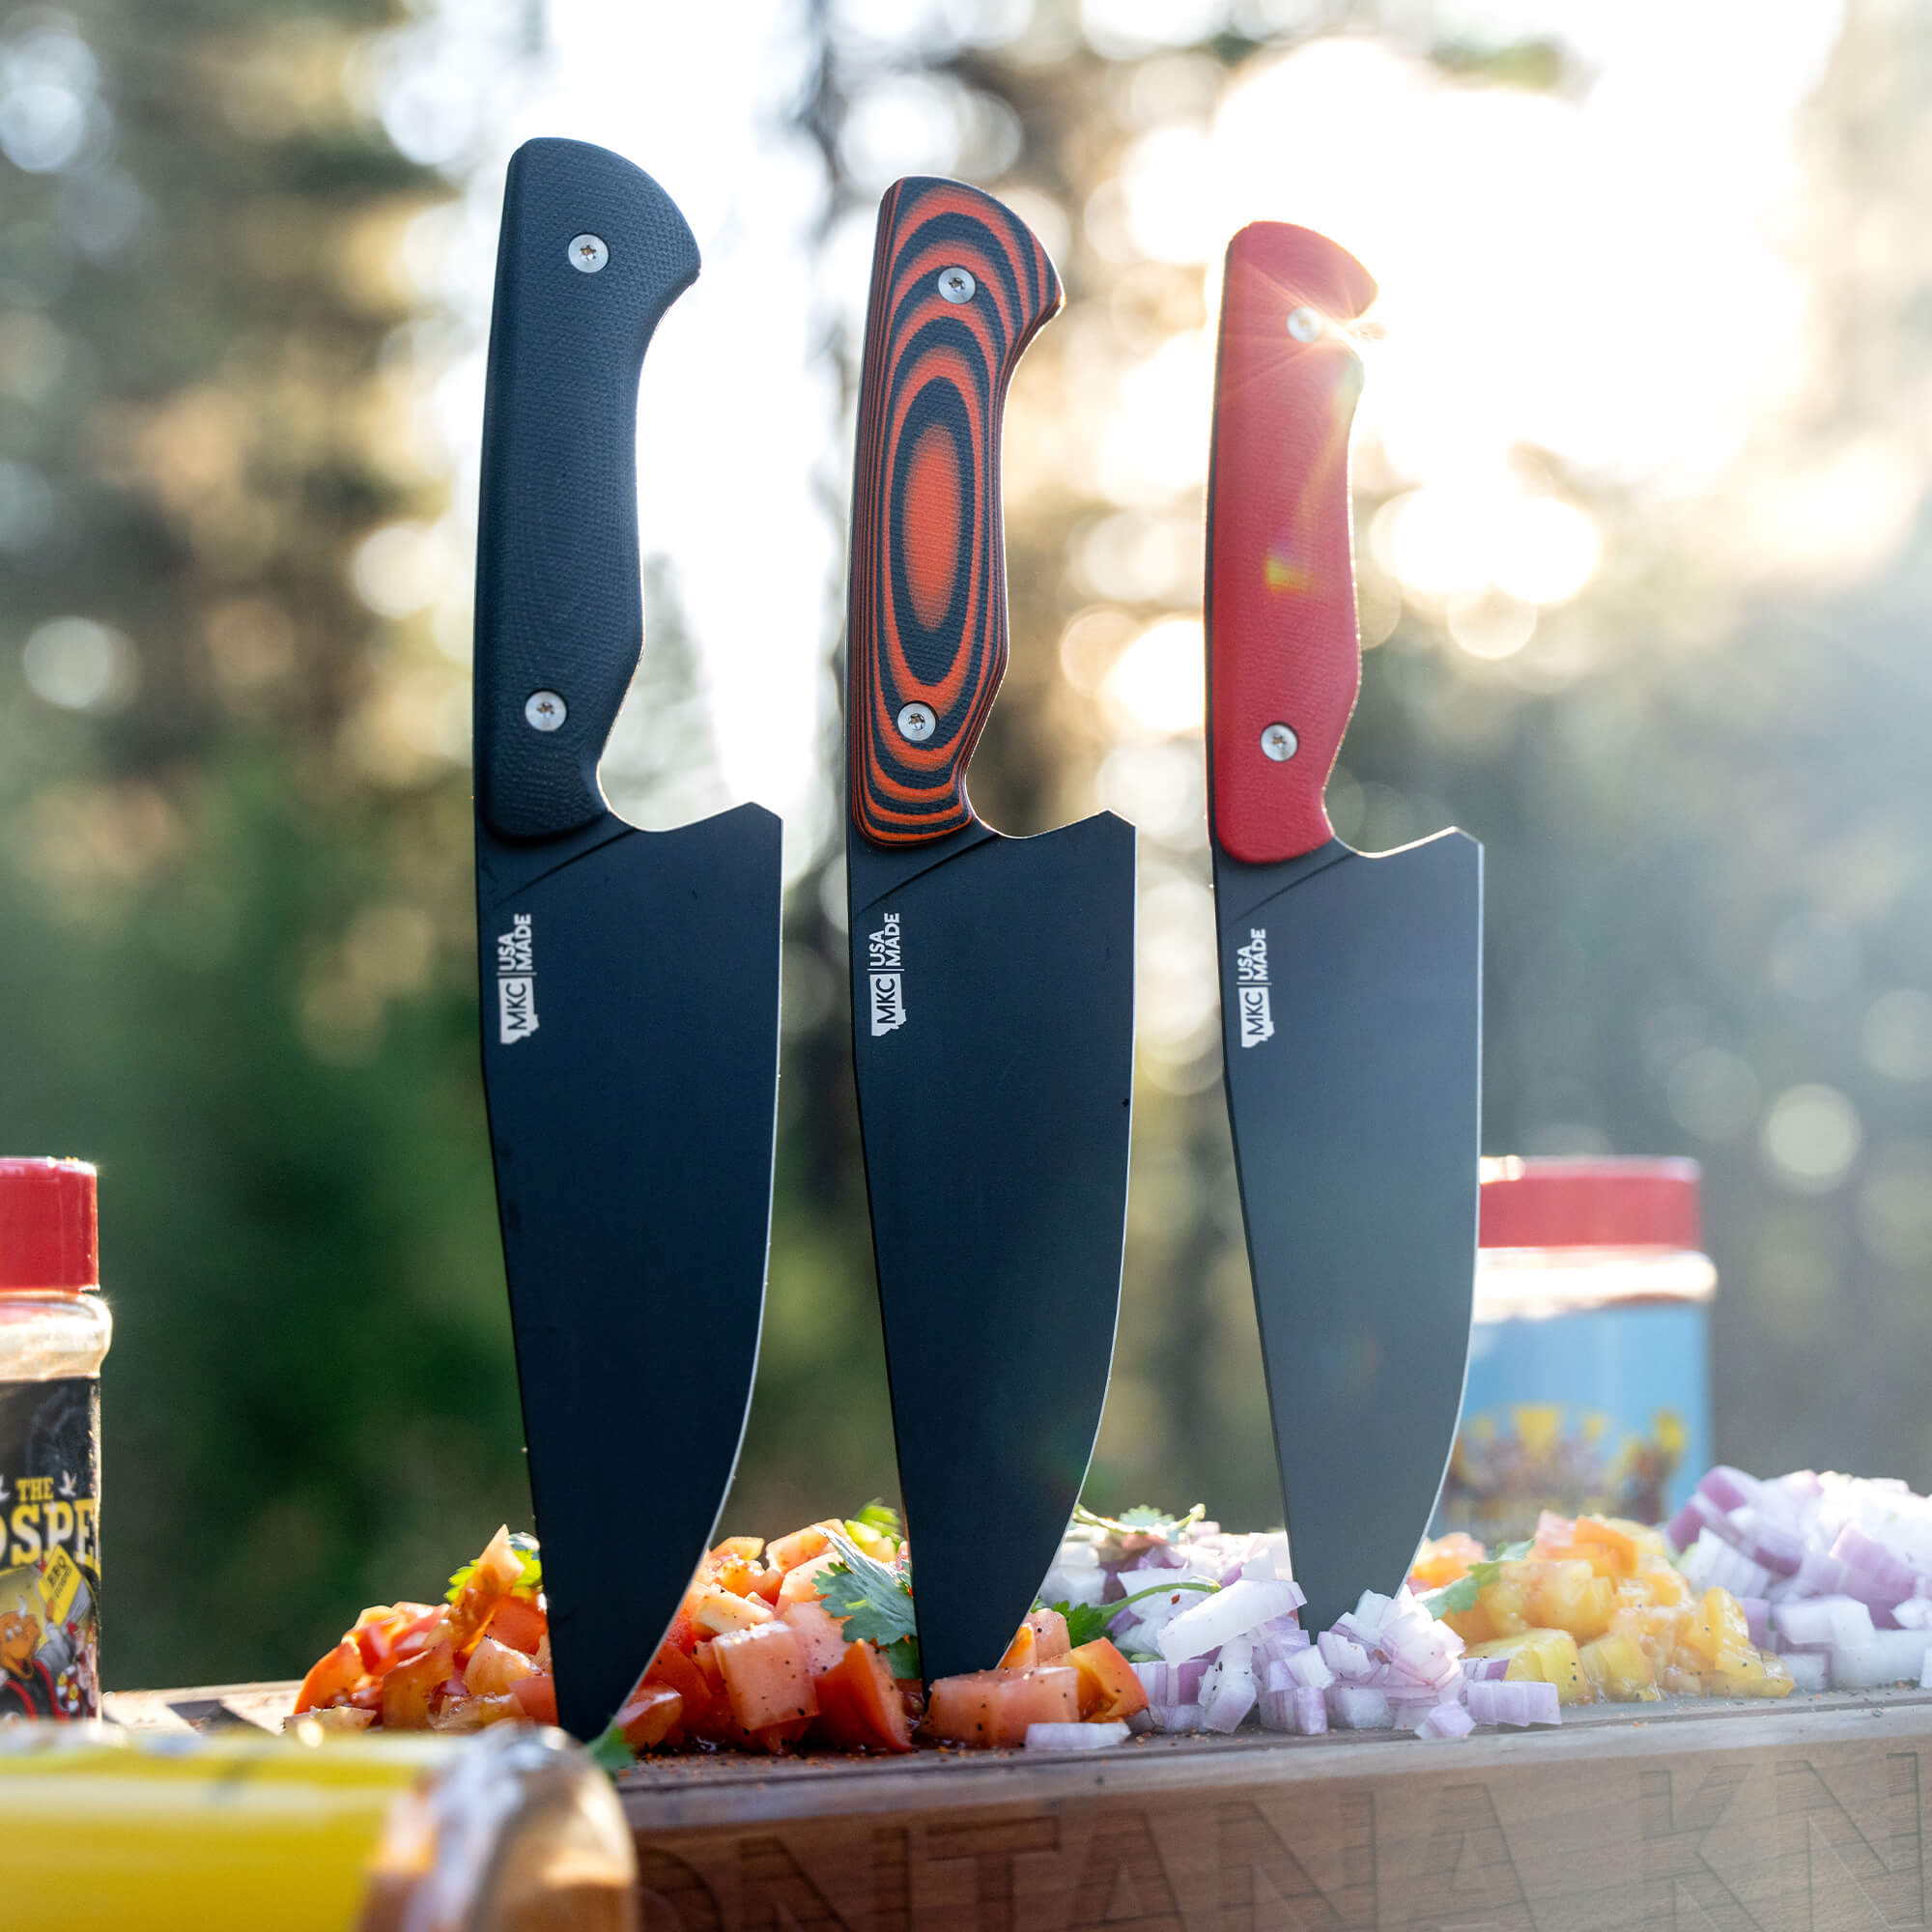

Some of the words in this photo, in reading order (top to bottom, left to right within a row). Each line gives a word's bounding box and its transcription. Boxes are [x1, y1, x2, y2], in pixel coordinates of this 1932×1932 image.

[497, 932, 516, 971] USA
[514, 913, 533, 971] MADE
[868, 929, 886, 967] USA
[883, 912, 901, 967] MADE
[1236, 945, 1254, 980] USA
[1250, 928, 1269, 980] MADE
[505, 982, 527, 1031] MKC
[875, 978, 896, 1024] MKC
[1244, 991, 1264, 1036] MKC
[15, 1476, 55, 1502] THE
[0, 1498, 95, 1570] SPE
